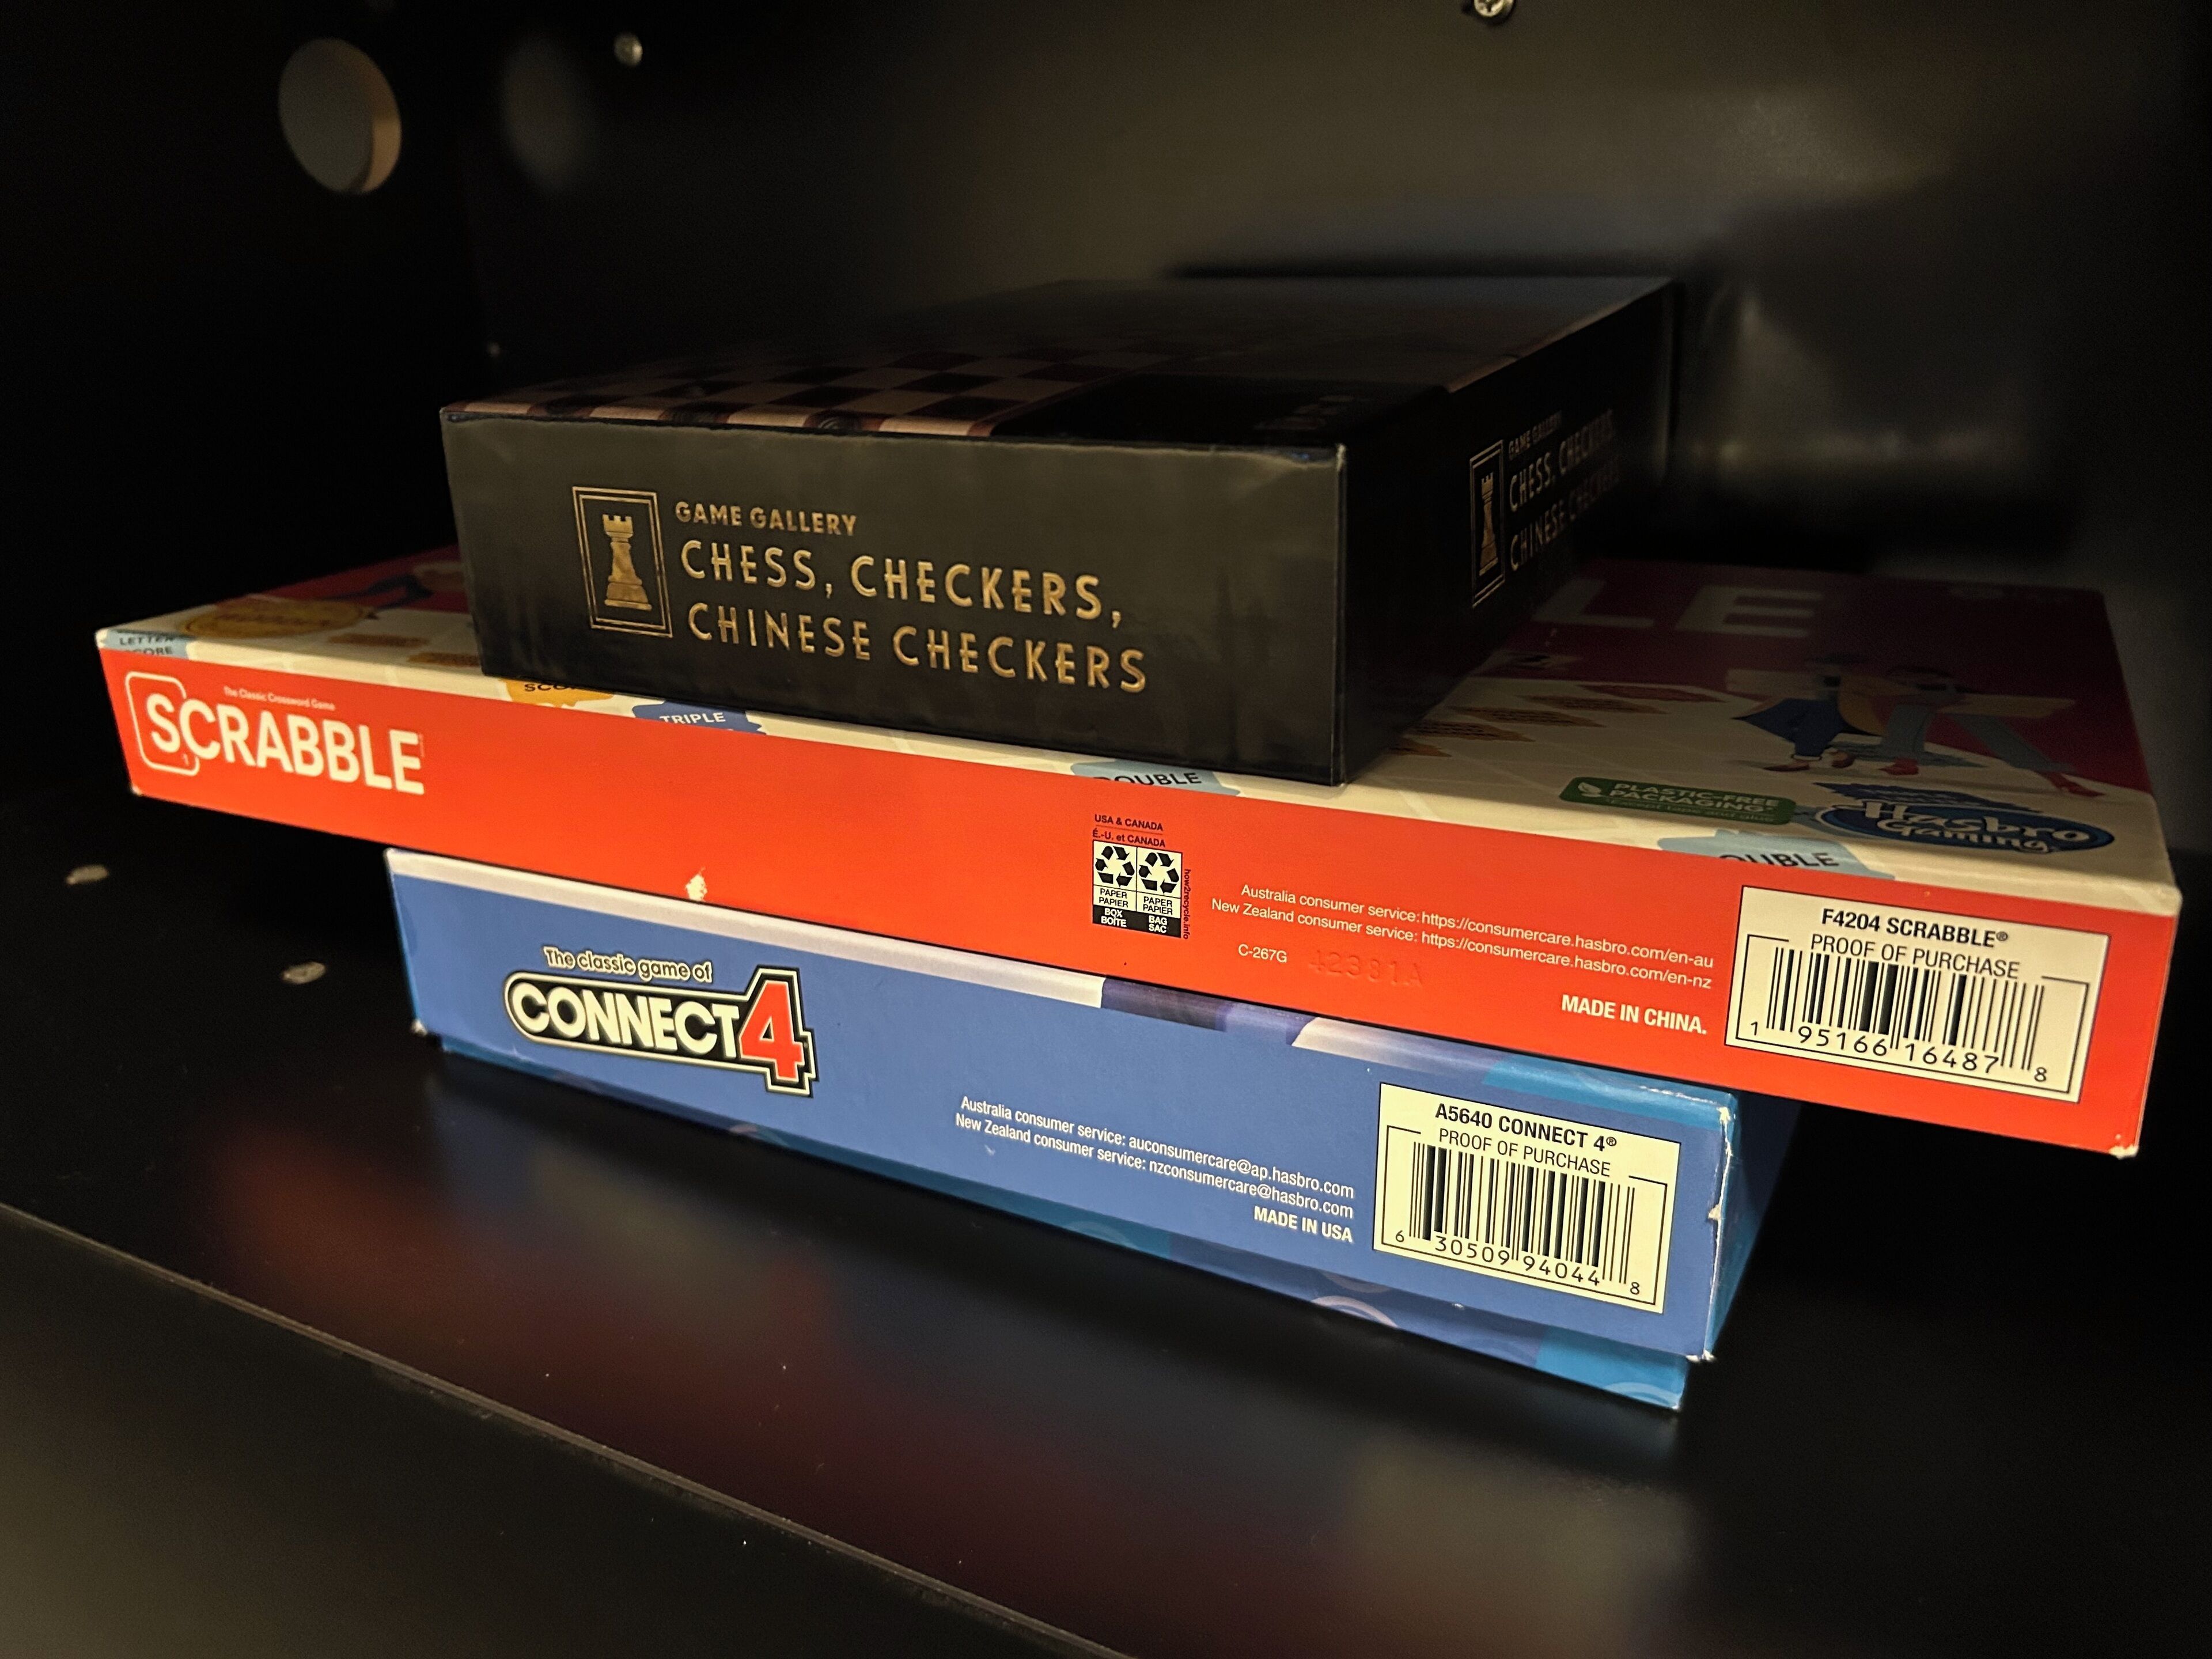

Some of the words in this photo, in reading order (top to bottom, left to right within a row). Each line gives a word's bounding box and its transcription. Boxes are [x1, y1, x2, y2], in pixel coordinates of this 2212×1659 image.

[675, 501, 743, 526] GAME
[750, 507, 857, 536] GALLERY
[681, 540, 833, 599] CHESS,
[851, 555, 1122, 628] CHECKERS,
[688, 603, 870, 661] CHINESE
[893, 626, 1146, 692] CHECKERS
[224, 685, 238, 698] The
[238, 688, 267, 702] Classic
[268, 693, 310, 708] Crossword
[311, 698, 336, 711] Game
[659, 712, 726, 725] TRIPLE
[146, 693, 425, 796] SCRABBLE
[1613, 783, 1779, 807] PLASTIC-FREE
[1092, 828, 1114, 840] É.-U.
[1127, 835, 1166, 847] CANADA
[1094, 814, 1113, 825] USA
[1116, 817, 1122, 825] &
[1124, 818, 1164, 831] CANADA
[1862, 801, 2090, 842] Hasbro
[1876, 818, 2051, 853] Gaming
[1099, 896, 1128, 908] PAPIER
[1100, 888, 1127, 899] PAPER
[1143, 896, 1173, 908] PAPER
[1143, 904, 1173, 916] PAPIER
[1183, 869, 1191, 940] how2recycle.info
[1241, 884, 1296, 904] Australia
[1299, 893, 1365, 914] consumer
[1104, 908, 1123, 918] BOX
[1149, 915, 1168, 926] BAG
[1149, 923, 1167, 934] SAC
[1822, 908, 1880, 932] F4204
[1887, 918, 2009, 948] SCRABBLE®
[1211, 897, 1240, 914] New
[1243, 903, 1294, 922] Zealand
[1297, 912, 1362, 934] consumer
[1366, 924, 1418, 942] service:
[1421, 931, 1711, 989] https://consumercare.hasbro.com/en-nz
[1238, 944, 1287, 963] C-267G
[1811, 934, 1875, 957] PROOF
[1881, 944, 1906, 961] OF
[1913, 949, 2020, 979] PURCHASE
[543, 948, 574, 968] The
[578, 952, 635, 974] classic
[637, 960, 689, 981] game
[692, 963, 712, 982] of
[512, 982, 740, 1058] CONNECT
[738, 980, 805, 1082] 4
[1562, 994, 1616, 1019] MADE
[1620, 1004, 1639, 1023] IN
[1644, 1008, 1707, 1035] CHINA.
[1751, 1021, 1759, 1036] 1
[1798, 1026, 1888, 1057] 95166
[1906, 1043, 1999, 1074] 16487
[2034, 1066, 2047, 1082] 8
[1435, 1103, 1492, 1128] A5640
[1499, 1116, 1588, 1148] CONNECT
[956, 1112, 981, 1131] New
[984, 1120, 1031, 1143] Zealand
[1034, 1133, 1094, 1157] consumer
[1097, 1147, 1146, 1170] service:
[1149, 1158, 1353, 1219] nzconsumercare@hasbro.com
[961, 1096, 1012, 1120] Australia
[1015, 1110, 1074, 1134] consumer
[1078, 1123, 1126, 1146] service:
[1129, 1135, 1354, 1199] auconsumercare@ap.hasbro.com
[1440, 1128, 1492, 1151] PROOF
[1497, 1140, 1518, 1157] OF
[1524, 1146, 1611, 1177] PURCHASE
[1254, 1206, 1297, 1229] MADE
[1301, 1217, 1317, 1234] IN
[1321, 1221, 1353, 1243] USA
[1395, 1230, 1405, 1243] 6
[1435, 1235, 1510, 1266] 30509
[1523, 1255, 1600, 1286] 94044
[1630, 1282, 1641, 1296] 8
